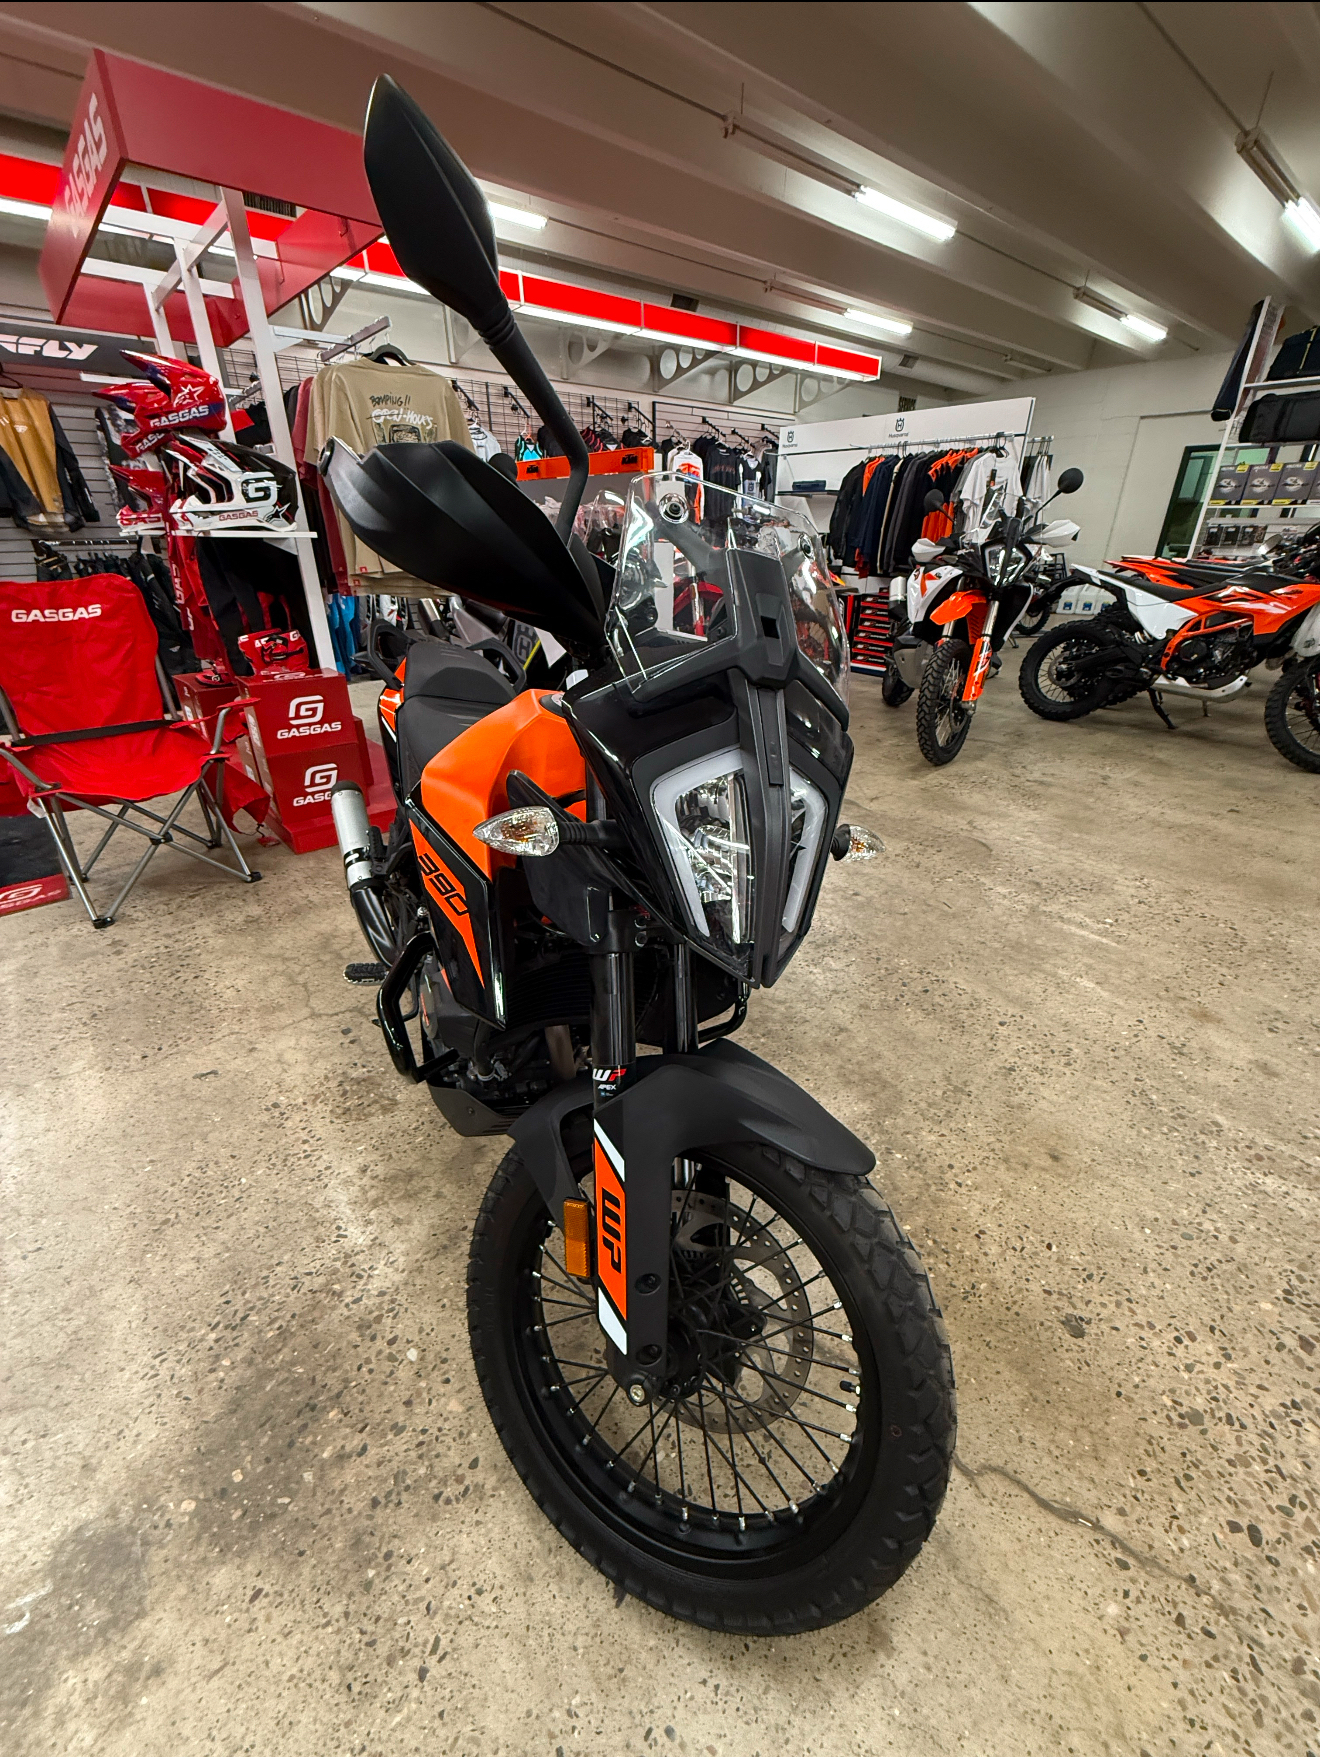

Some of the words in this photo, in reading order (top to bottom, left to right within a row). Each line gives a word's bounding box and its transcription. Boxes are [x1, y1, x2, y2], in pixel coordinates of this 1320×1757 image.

[64, 92, 107, 239] GASGAS
[17, 336, 99, 360] FLY
[150, 404, 209, 427] GASGAS
[136, 433, 165, 454] GAS
[218, 510, 258, 521] GASGAS
[11, 604, 102, 622] GASGAS
[277, 721, 342, 739] GASGAS
[293, 793, 333, 807] GASG
[418, 852, 469, 916] 390
[592, 1068, 627, 1081] WP
[602, 1186, 622, 1274] WP
